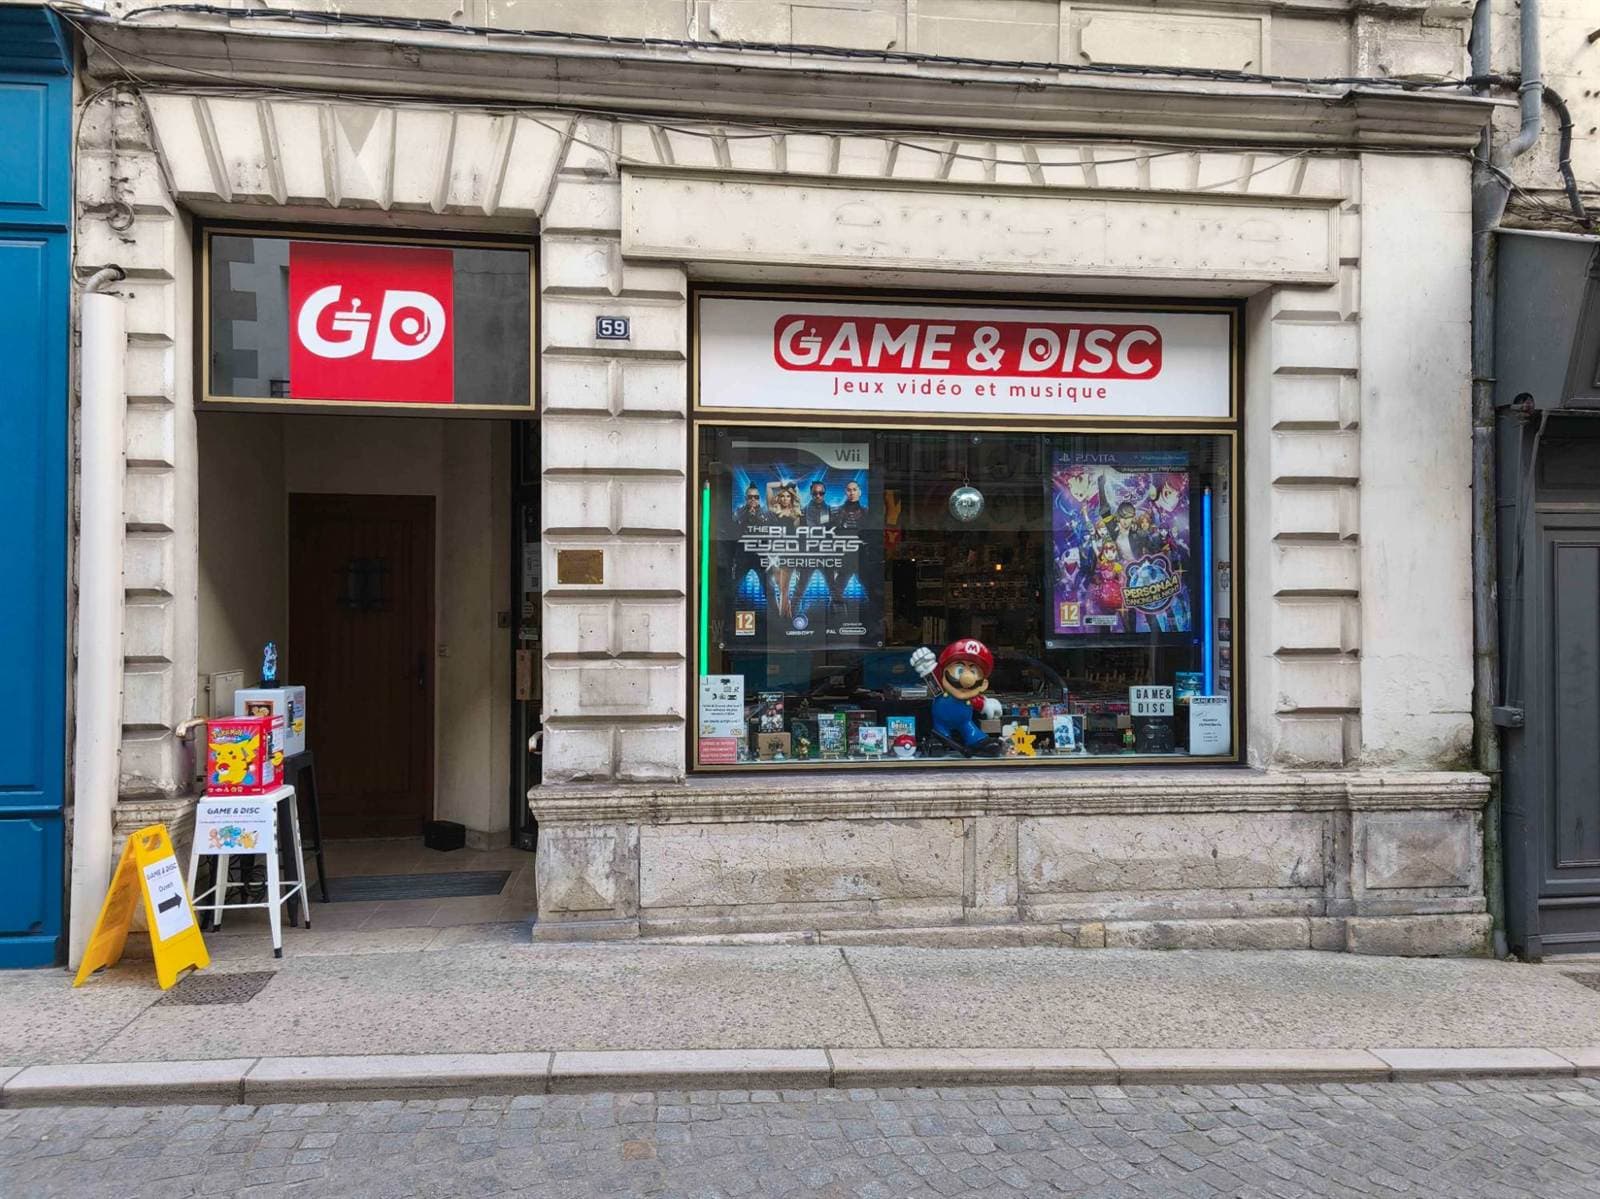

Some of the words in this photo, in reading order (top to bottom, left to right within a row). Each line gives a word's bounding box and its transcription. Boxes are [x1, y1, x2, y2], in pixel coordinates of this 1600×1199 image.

[602, 320, 625, 335] 59
[779, 319, 956, 370] GAME
[966, 326, 1005, 371] &
[1018, 328, 1157, 375] DISC
[833, 377, 884, 395] Jeux
[897, 379, 962, 396] vidéo
[975, 382, 997, 397] et
[1009, 383, 1107, 402] musique
[835, 449, 861, 462] Wii
[747, 525, 769, 533] THE
[769, 525, 837, 539] BLACK
[741, 539, 800, 552] EYED
[805, 540, 863, 553] PEAS
[760, 556, 842, 569] EXPERIENCE
[1062, 604, 1079, 620] 12
[737, 612, 753, 628] 12
[1138, 703, 1165, 713] DISC
[207, 807, 232, 815] GAME
